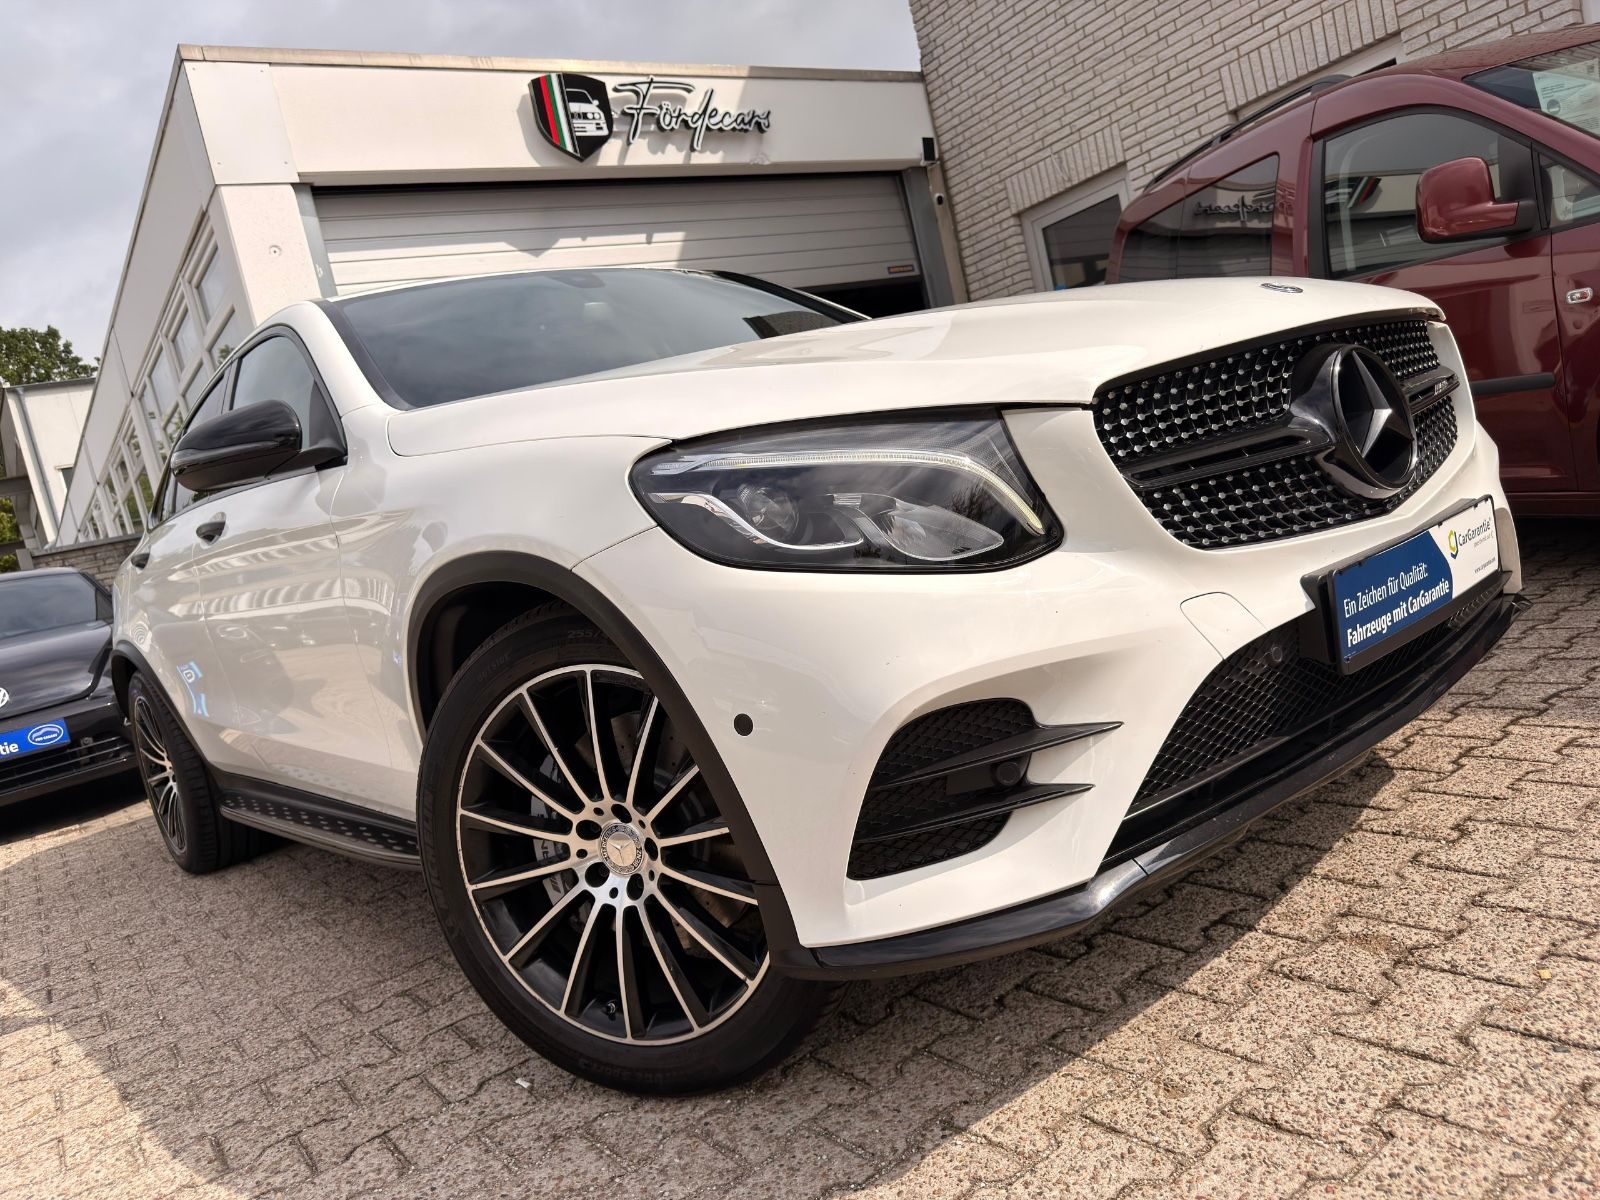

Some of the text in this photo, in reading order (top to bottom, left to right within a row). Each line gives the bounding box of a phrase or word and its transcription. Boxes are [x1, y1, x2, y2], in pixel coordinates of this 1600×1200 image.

[612, 75, 771, 151] Fördecars
[1344, 562, 1428, 618] Ein Zeichen für Qualität:
[1347, 577, 1450, 648] Fahrzeuge mit CarGarantie
